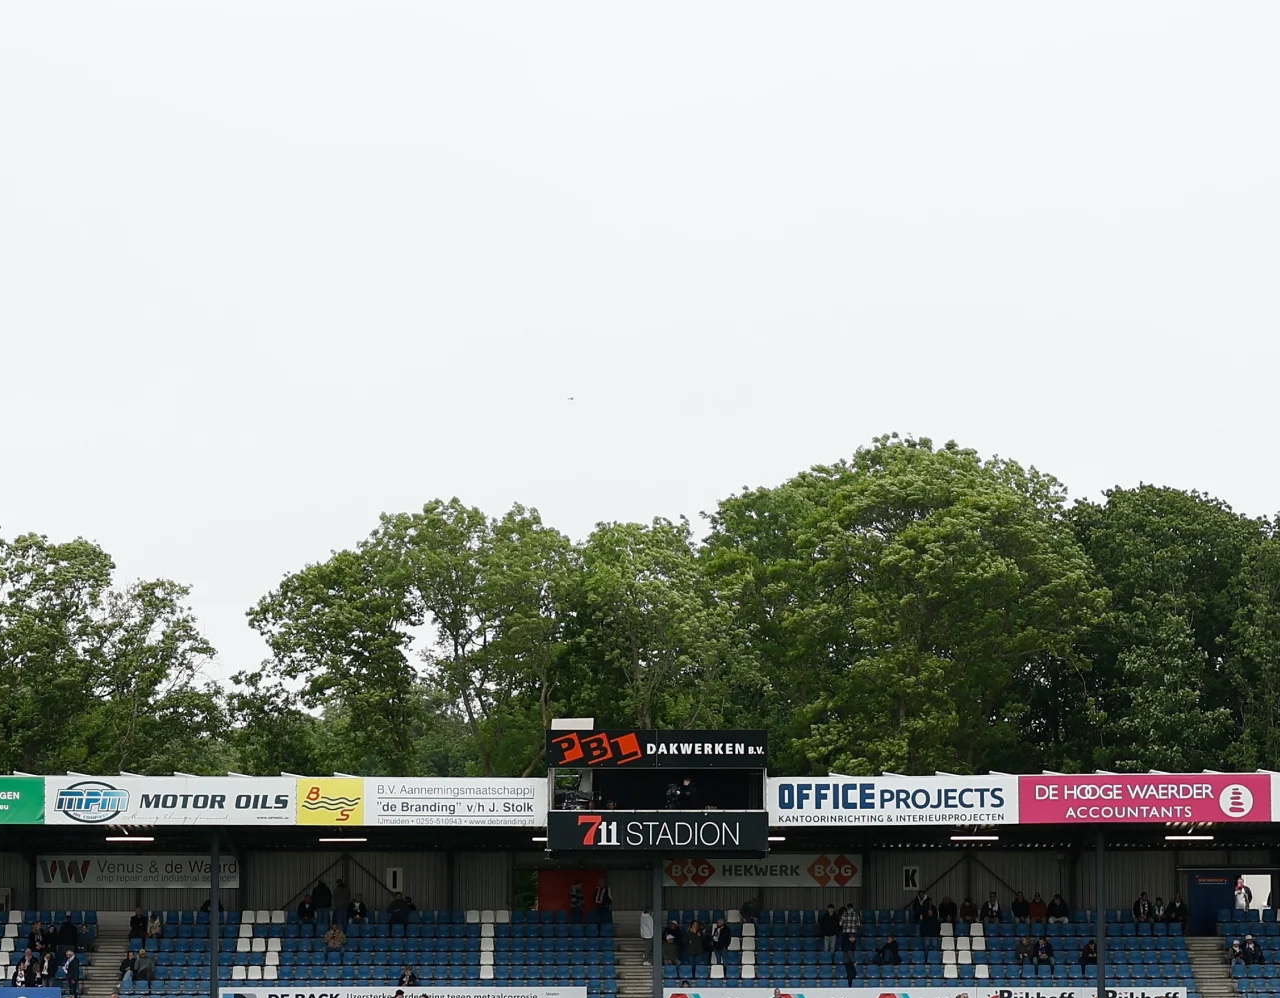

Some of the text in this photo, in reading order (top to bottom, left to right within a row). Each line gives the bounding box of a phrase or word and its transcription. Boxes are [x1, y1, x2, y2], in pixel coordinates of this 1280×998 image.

[552, 732, 765, 764] PBL DAKWERKEN B.V.
[306, 786, 321, 801] B
[377, 785, 535, 798] B.V. Aannemingsmaatschappij
[1035, 783, 1214, 800] DE HOOGE WAERDER
[140, 794, 289, 809] MOTOR OILS
[466, 802, 485, 813] v/h
[488, 802, 499, 812] J.
[503, 801, 534, 812] Stolk
[336, 808, 356, 821] S
[778, 813, 1004, 823] KANTOORINRICHTING & INTERIEURPROJECTEN
[1065, 806, 1192, 819] ACCOUNTANTS
[577, 815, 740, 846] 711 STADION
[97, 860, 183, 874] Venus & de
[671, 864, 852, 877] B&G HEKWERK B&G
[96, 874, 200, 883] ship repair and industrial
[904, 869, 918, 888] K
